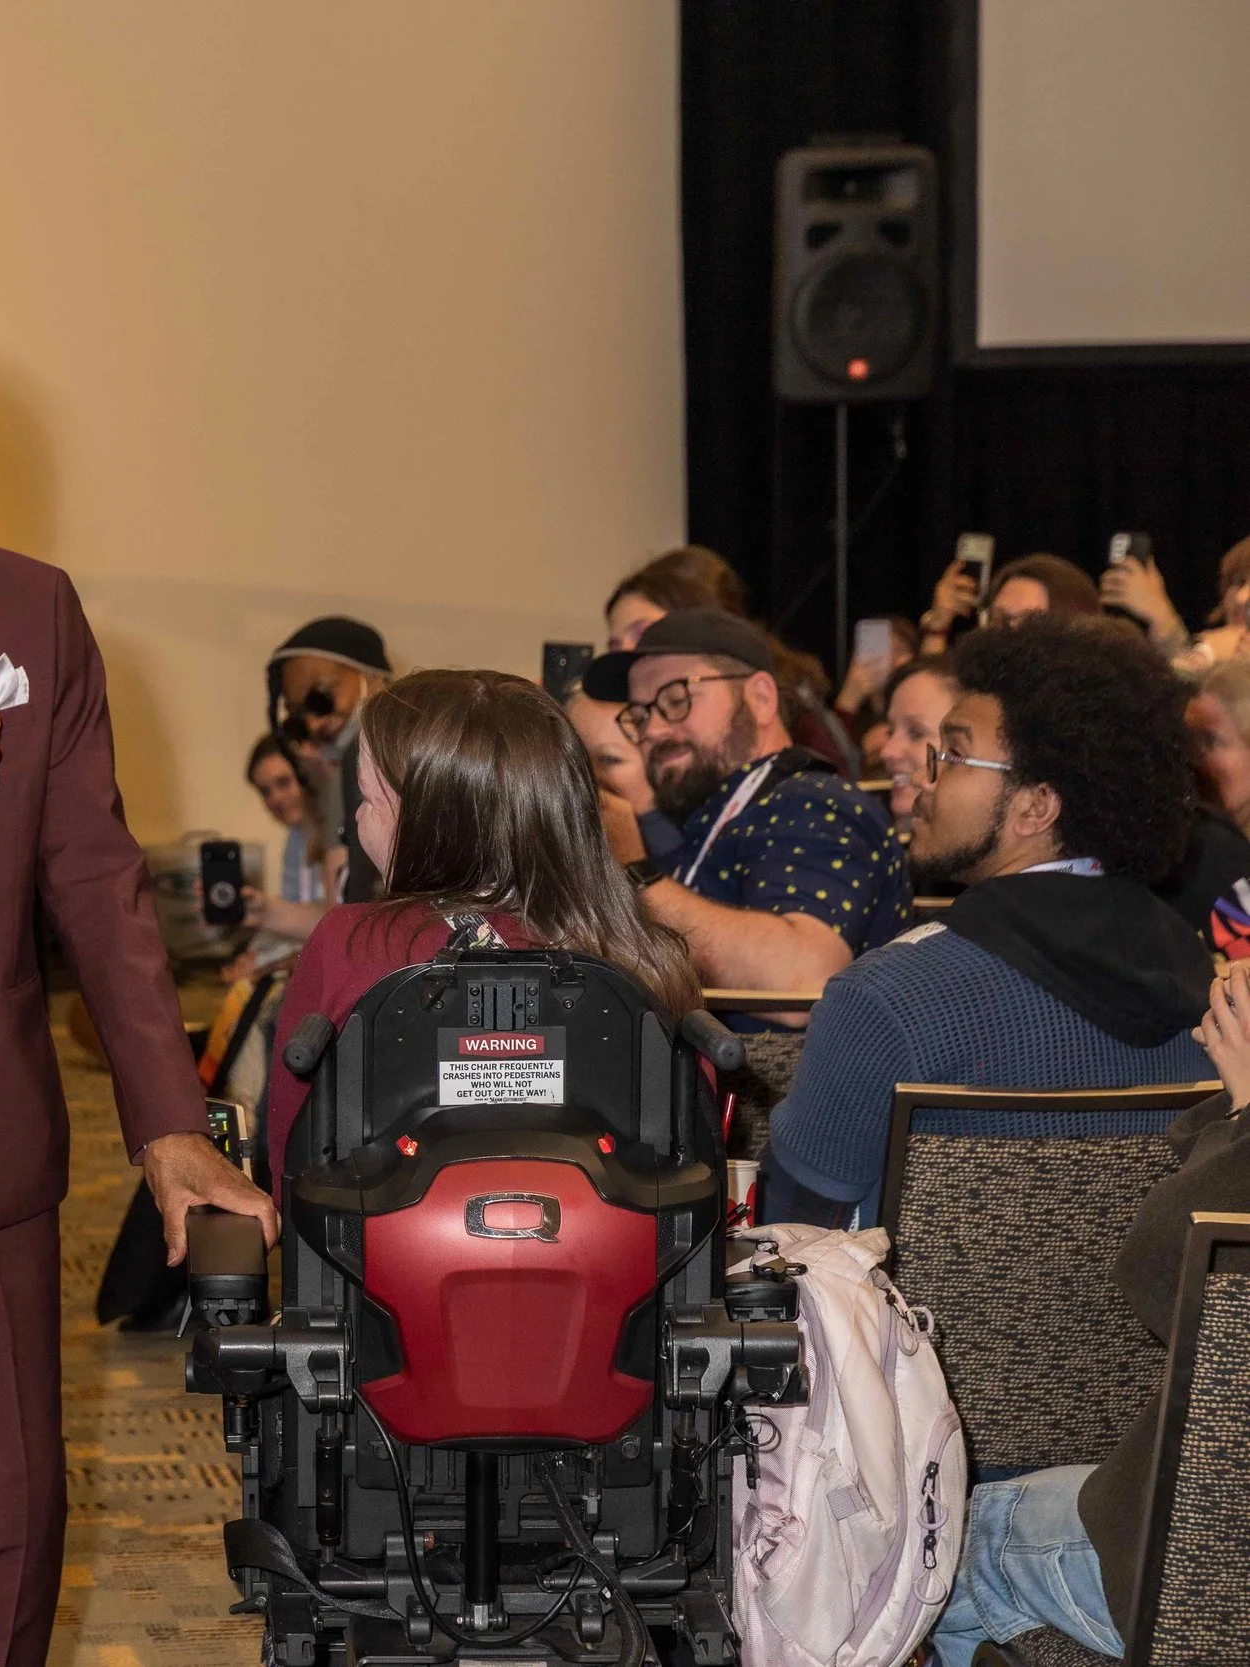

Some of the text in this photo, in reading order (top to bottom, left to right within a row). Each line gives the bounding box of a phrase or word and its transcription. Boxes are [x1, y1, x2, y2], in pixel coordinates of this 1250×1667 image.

[466, 1039, 537, 1051] WARNING
[450, 1062, 554, 1071] THIS CHAIR FREQUENTLY
[443, 1072, 481, 1080] CRASHES
[504, 1071, 560, 1079] PEDESTRIANS
[515, 1080, 532, 1088] NOT
[457, 1090, 472, 1098] GET
